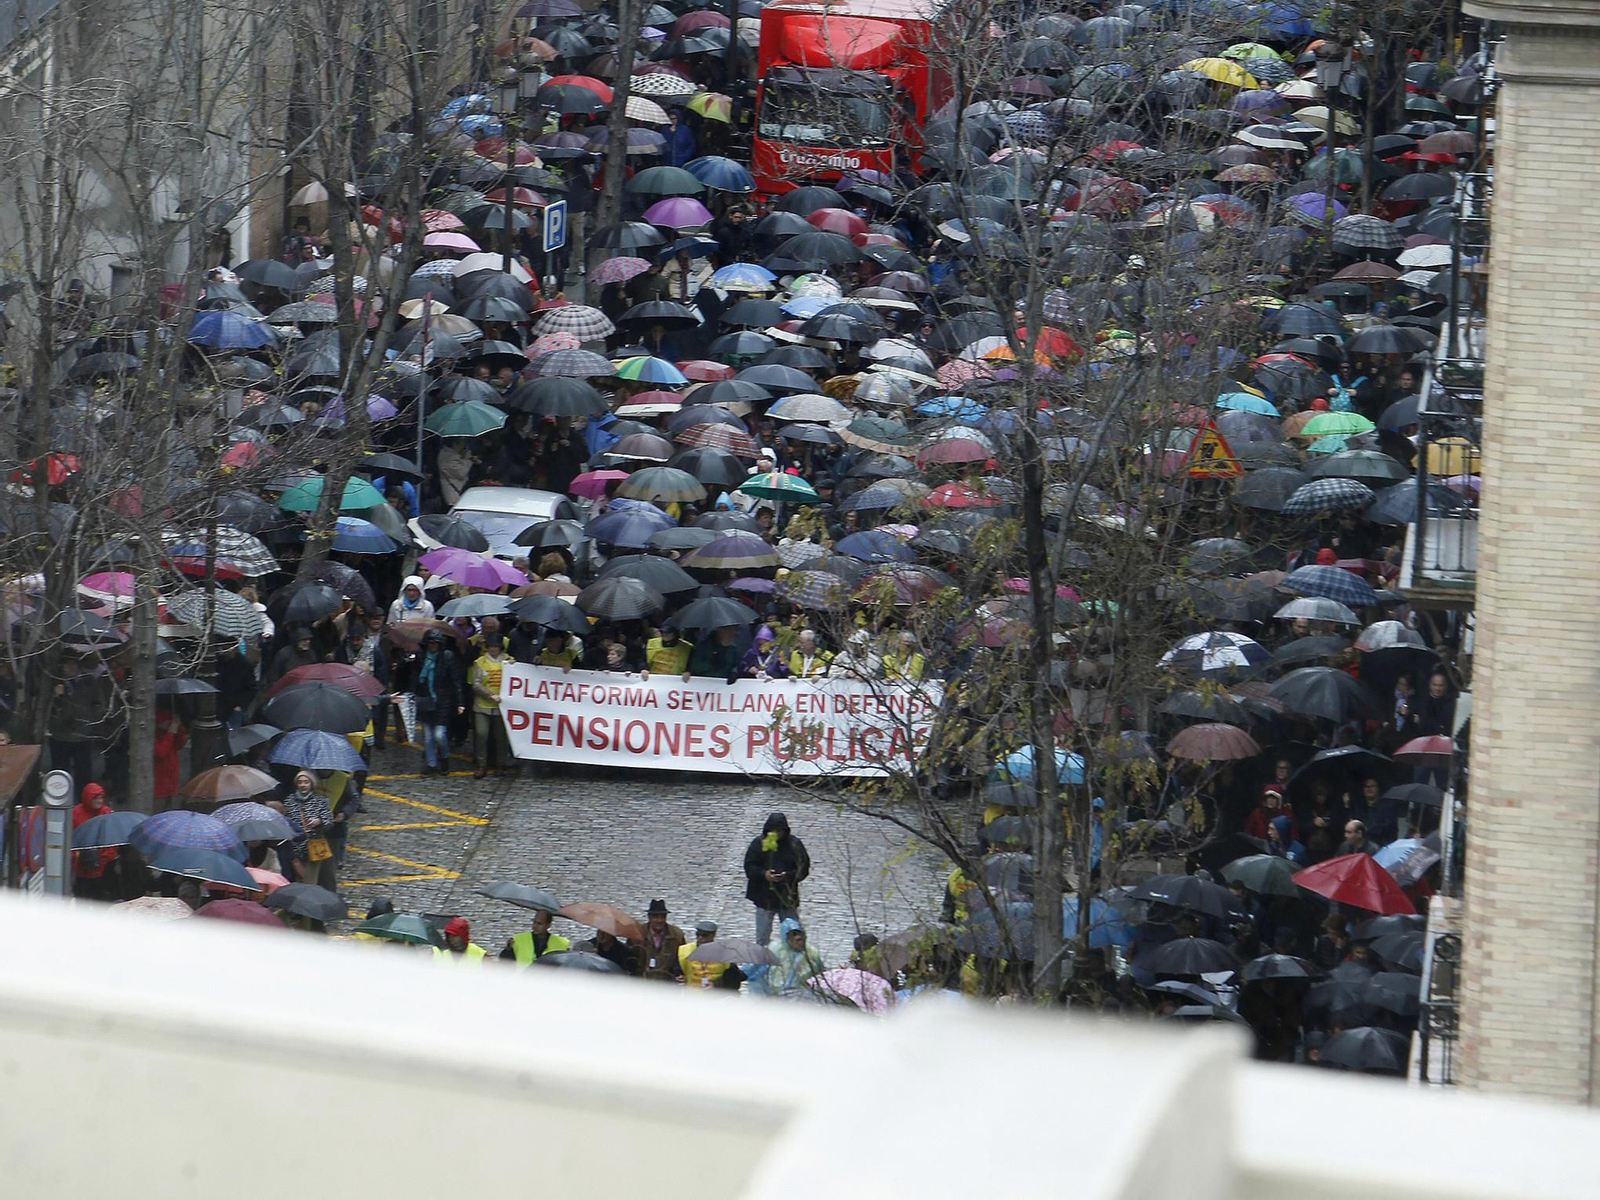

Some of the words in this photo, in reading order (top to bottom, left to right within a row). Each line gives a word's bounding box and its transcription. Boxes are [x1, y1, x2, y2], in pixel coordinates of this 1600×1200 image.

[549, 209, 562, 246] P
[508, 676, 659, 709] PLATAFORMA
[666, 689, 787, 713] SEVILLANA
[796, 693, 826, 714] EN
[834, 694, 933, 715] DEFENSA
[507, 709, 731, 759] PENSIONES
